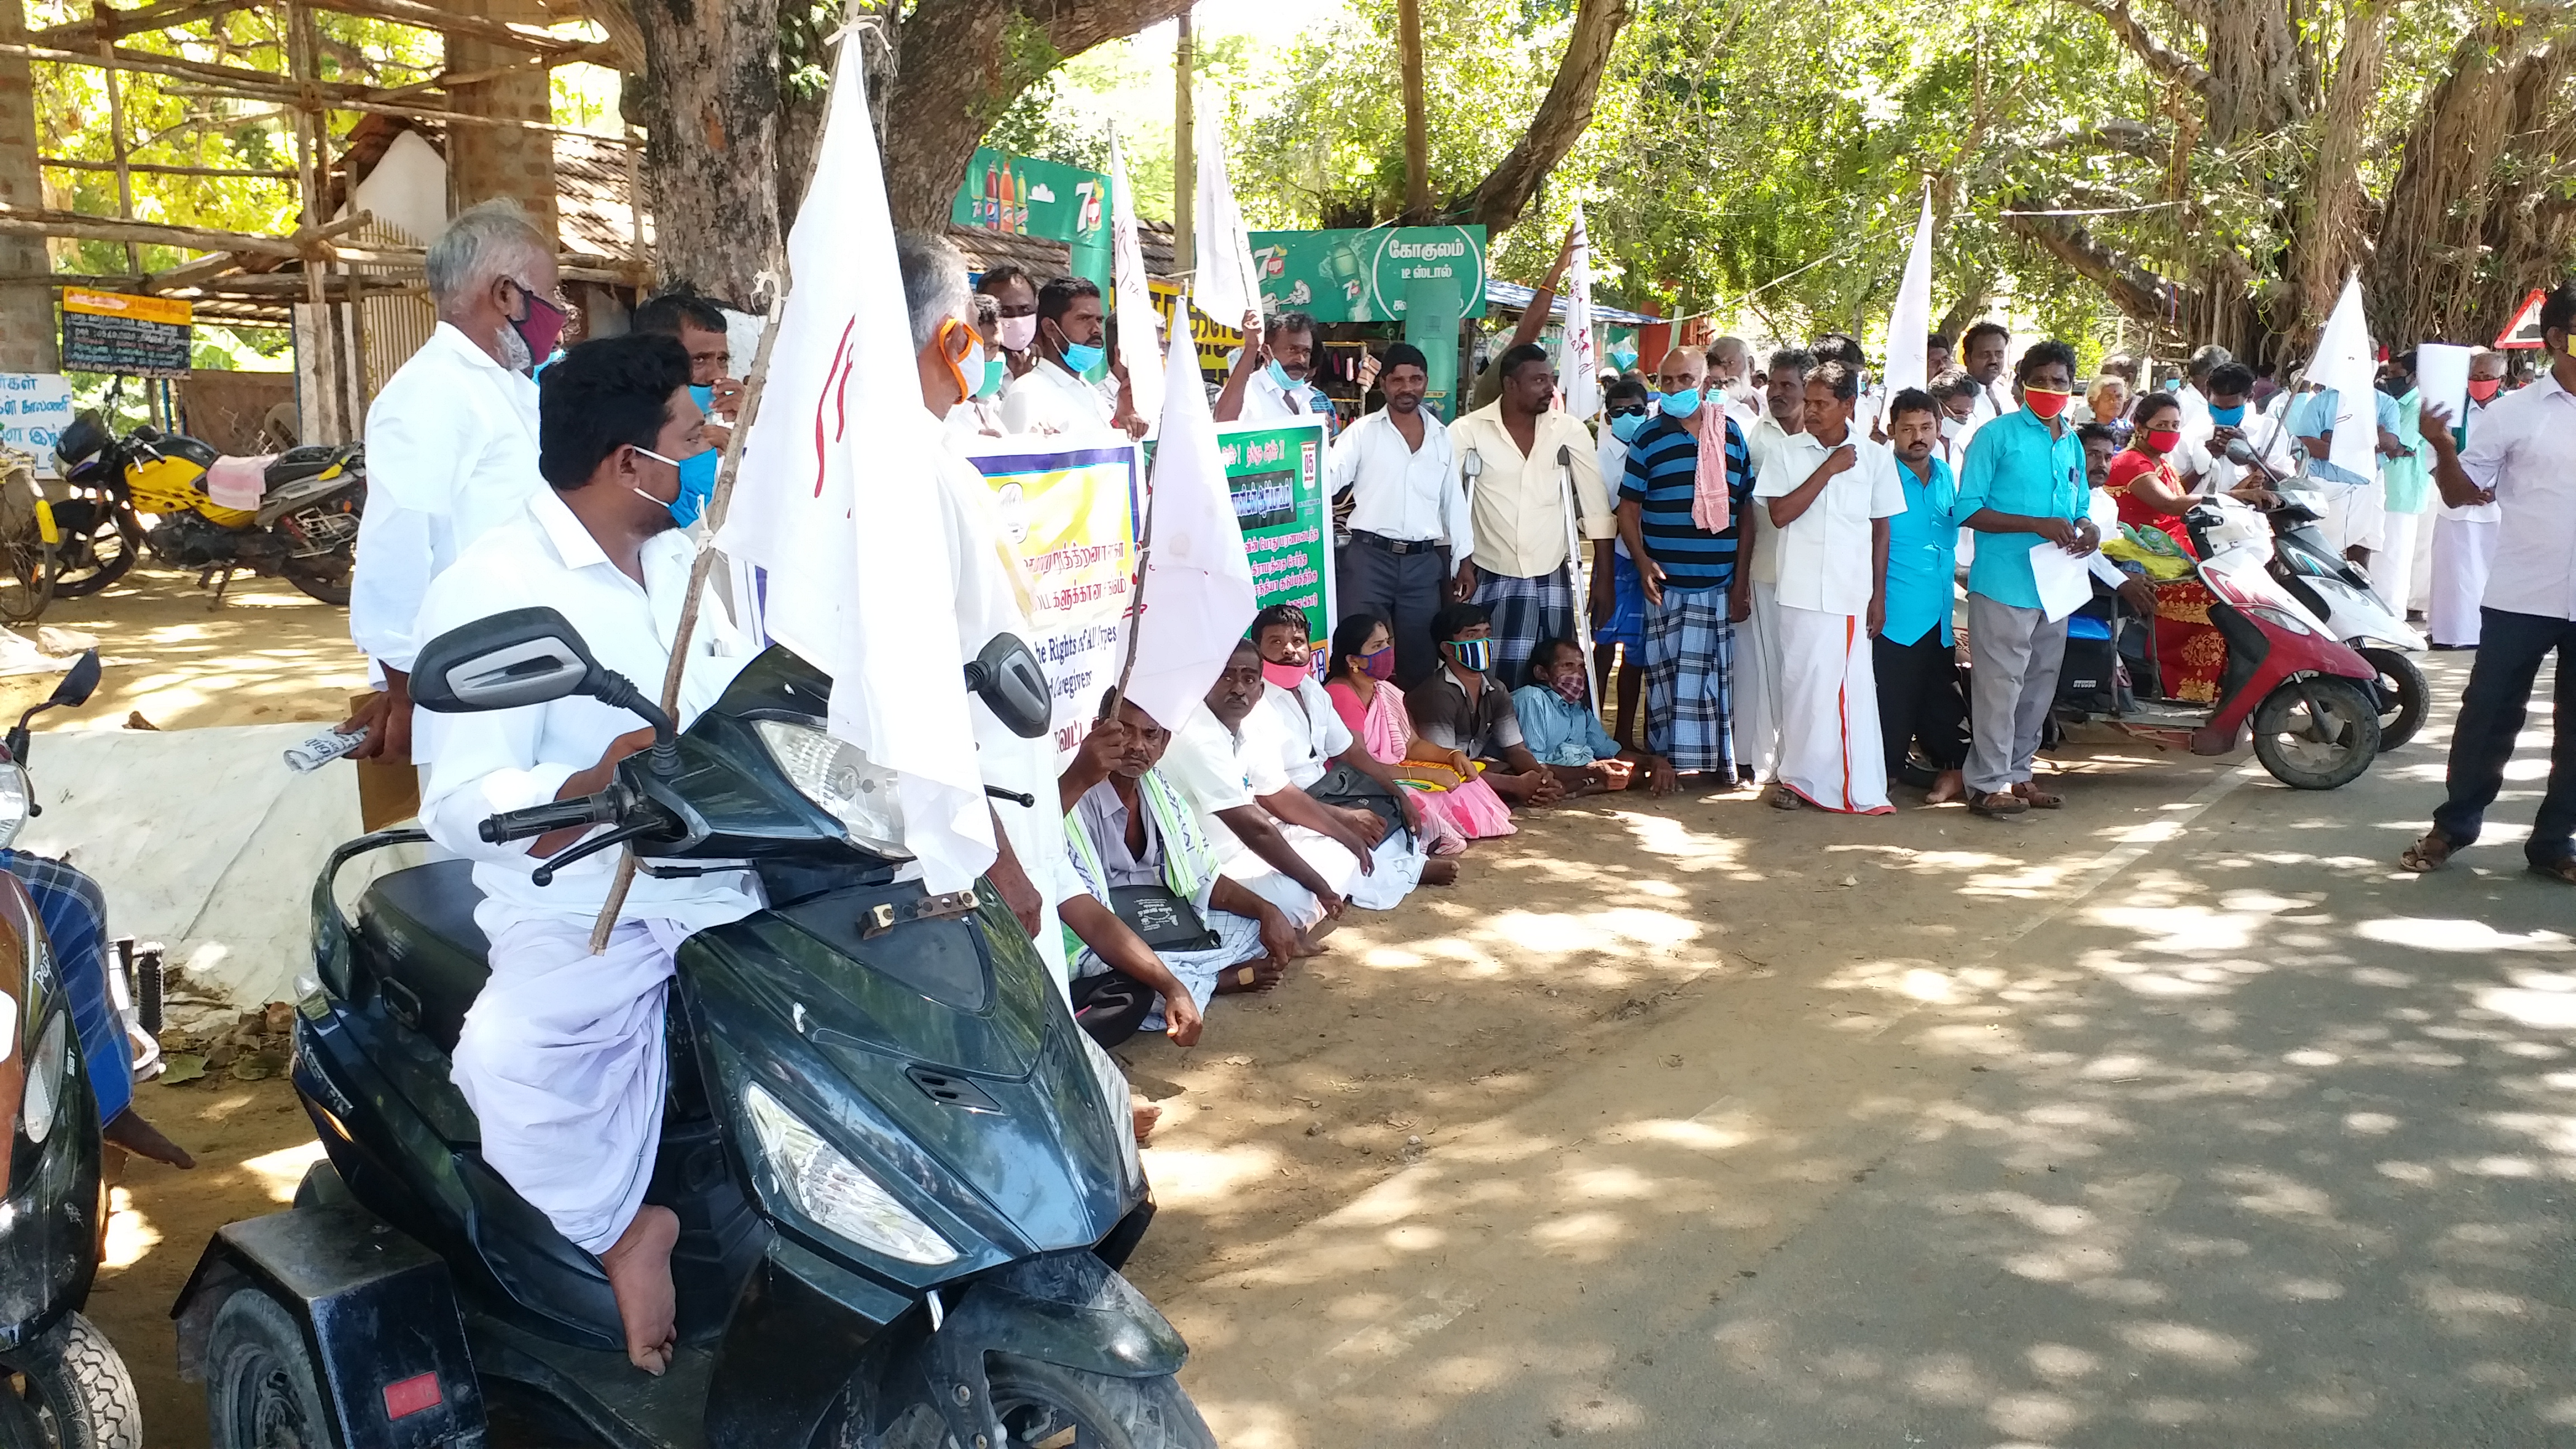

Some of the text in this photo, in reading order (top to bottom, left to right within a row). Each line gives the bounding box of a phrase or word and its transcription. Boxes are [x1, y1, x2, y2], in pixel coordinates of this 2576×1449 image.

[1389, 238, 1465, 261] கோகுலம்
[1413, 263, 1452, 278] ஸ்டால்
[1305, 453, 1314, 474] 05
[1048, 633, 1077, 666] Rights
[1078, 628, 1087, 653] of
[1097, 625, 1117, 651] Types
[1053, 668, 1092, 699] Caregivers
[67, 1047, 76, 1077] SBT
